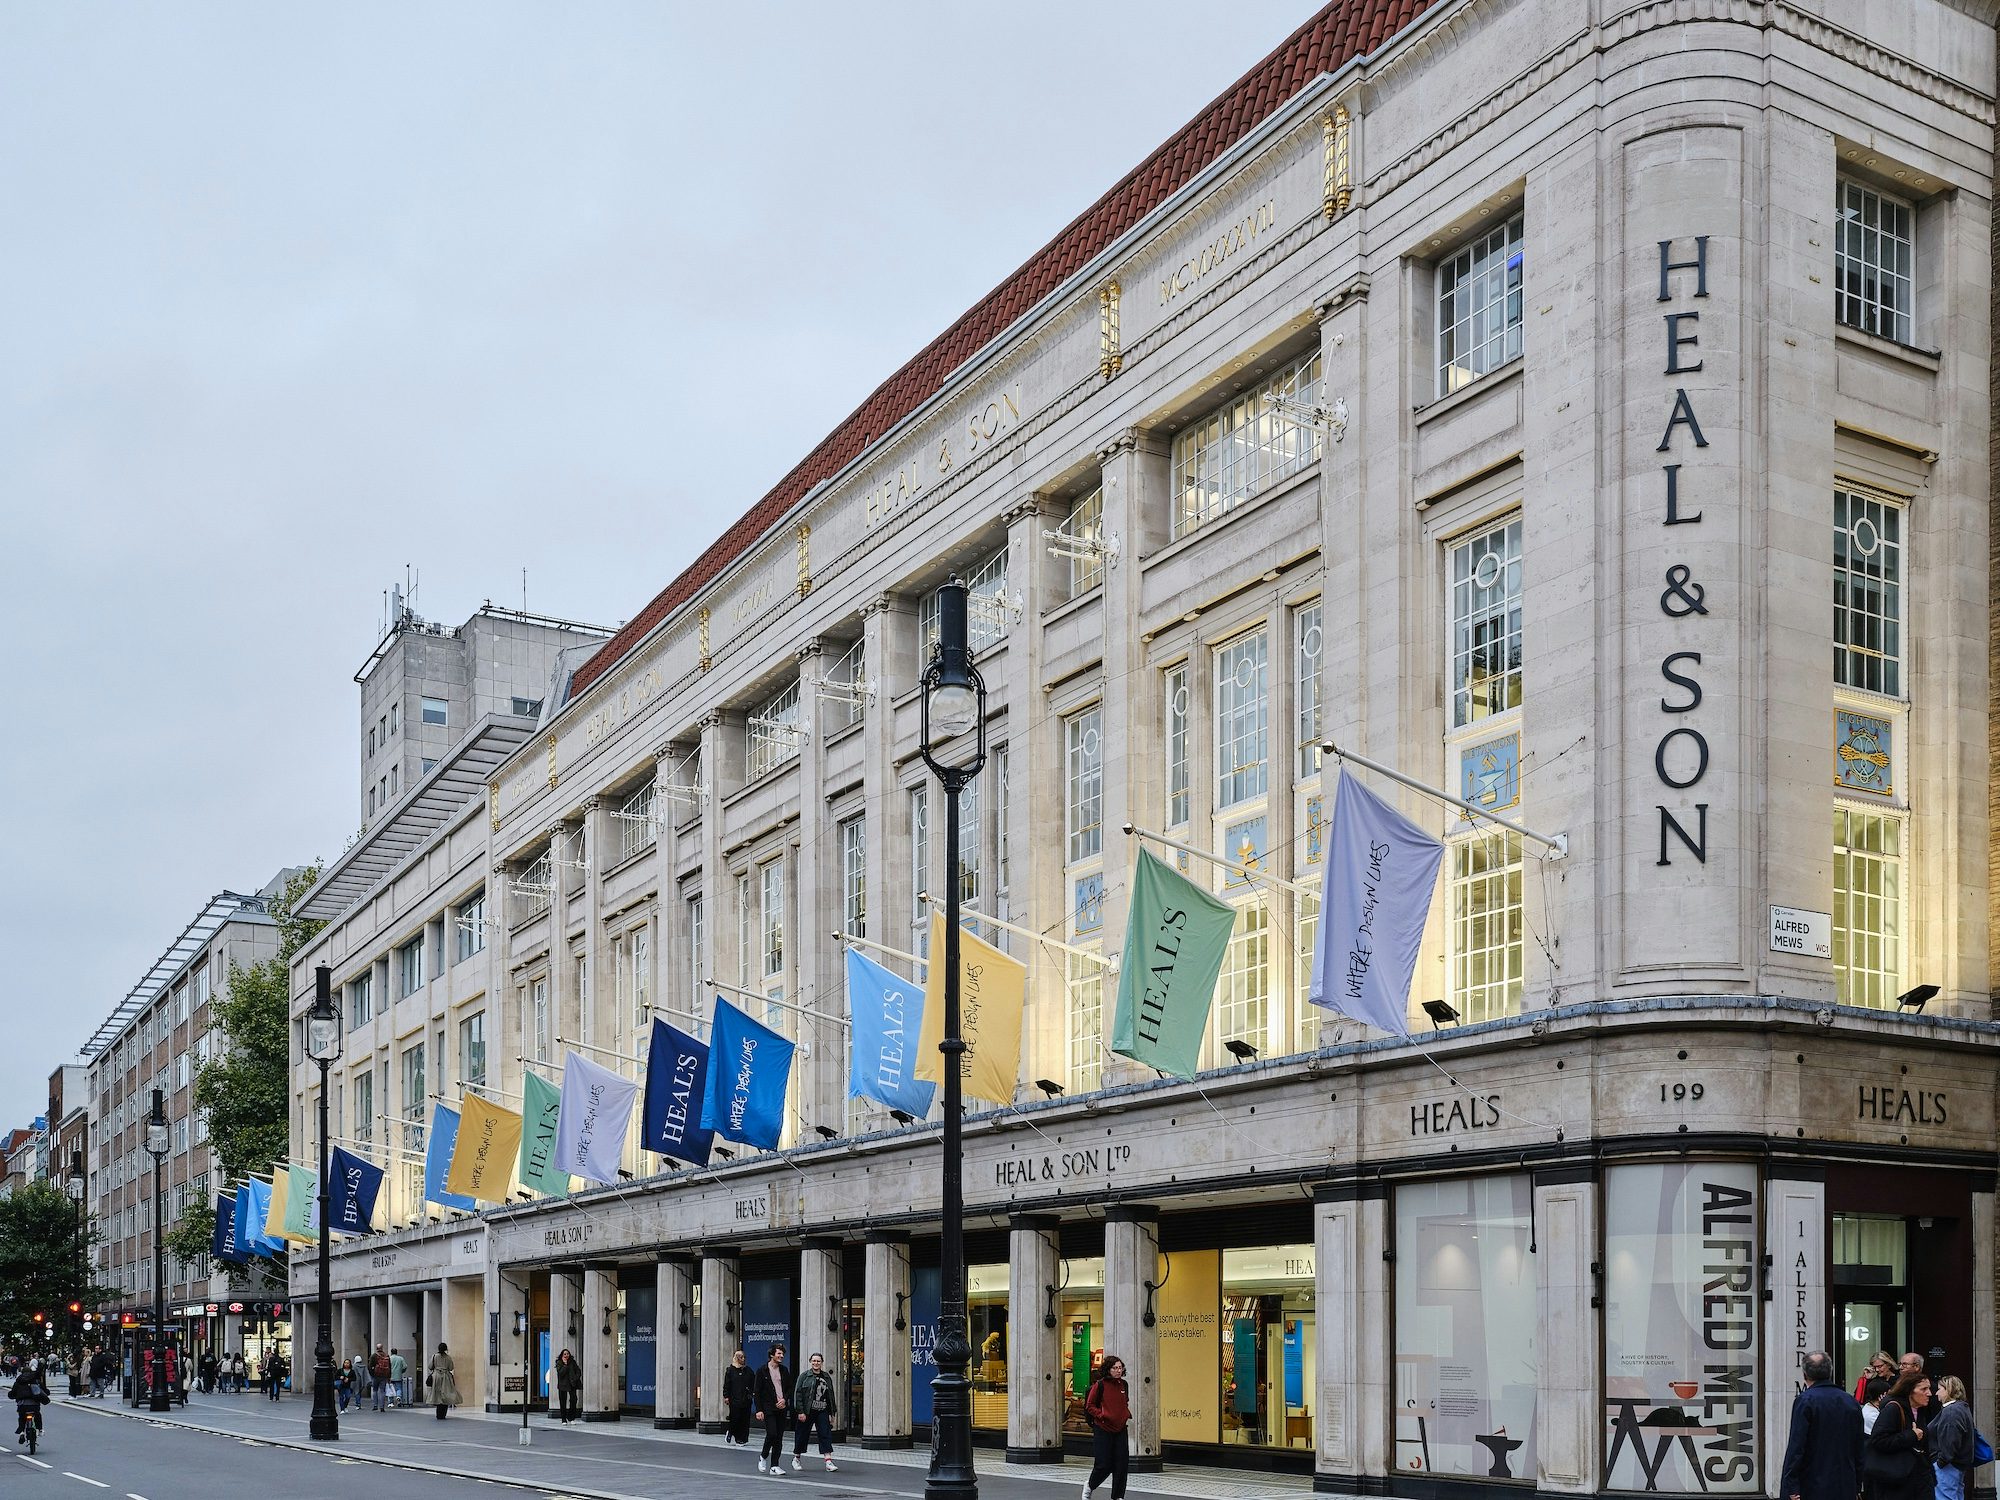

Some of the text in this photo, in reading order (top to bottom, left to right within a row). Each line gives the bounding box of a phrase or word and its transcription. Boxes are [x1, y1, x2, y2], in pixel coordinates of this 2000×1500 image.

[1160, 199, 1274, 306] MCMXXXVII
[866, 383, 1020, 528] HEAL & SON
[1655, 235, 1710, 866] HEAL & SON
[586, 703, 615, 747] HEAL
[636, 663, 662, 706] SON
[1839, 711, 1889, 732] LIGHTING
[1346, 840, 1390, 999] WHERE DESIGN LIVES
[1774, 919, 1810, 934] ALFRED
[1774, 935, 1829, 953] MEWS WC1
[966, 963, 983, 992] LIVES
[1138, 906, 1187, 1047] HEAL'S
[963, 993, 982, 1033] DESIGN
[877, 989, 904, 1091] HEAL'S
[662, 1053, 698, 1145] HEAL'S
[730, 1037, 757, 1130] WHERE DESIGN LIVES
[1660, 1083, 1704, 1103] 199
[1859, 1086, 1947, 1123] HEAL'S
[528, 1103, 560, 1180] HEAL'S
[576, 1084, 605, 1167] WHERE DESIGN LIVES
[471, 1163, 484, 1189] WHERE
[996, 1159, 1036, 1186] HEAL
[1042, 1156, 1054, 1180] &
[1062, 1149, 1099, 1178] SON
[735, 1197, 766, 1219] HEAL'S
[545, 1230, 560, 1245] HEAL
[562, 1229, 567, 1243] &
[569, 1226, 581, 1242] SON
[1799, 1220, 1804, 1237] 1
[1163, 1328, 1184, 1340] always
[1188, 1313, 1199, 1322] the
[1200, 1313, 1214, 1323] best
[1702, 1182, 1754, 1483] ALFRED MEWS
